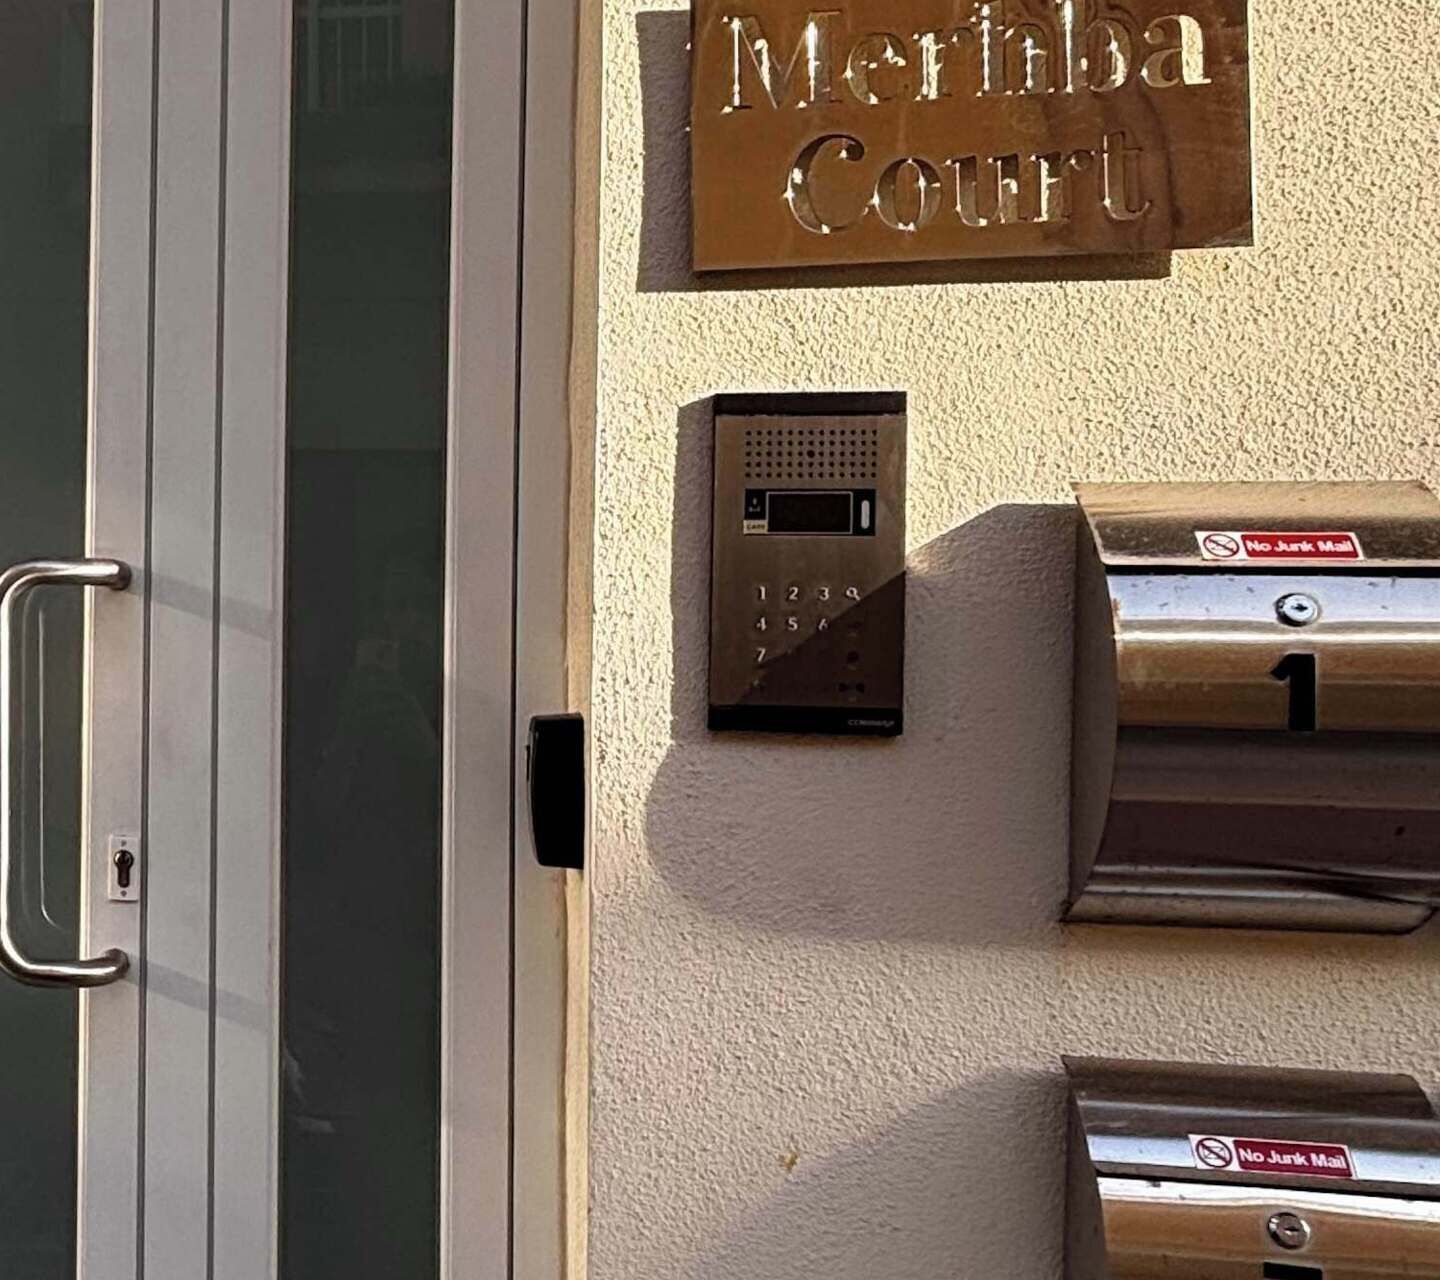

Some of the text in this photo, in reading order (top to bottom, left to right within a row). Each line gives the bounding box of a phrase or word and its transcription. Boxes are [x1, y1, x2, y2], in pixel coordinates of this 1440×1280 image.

[782, 130, 1153, 235] Court
[1245, 540, 1354, 552] No Junk Mail
[759, 586, 830, 600] 1 2 3
[788, 617, 798, 631] 5
[756, 648, 766, 662] 7
[1269, 652, 1317, 732] 1
[1239, 1148, 1348, 1169] No Junk Mail
